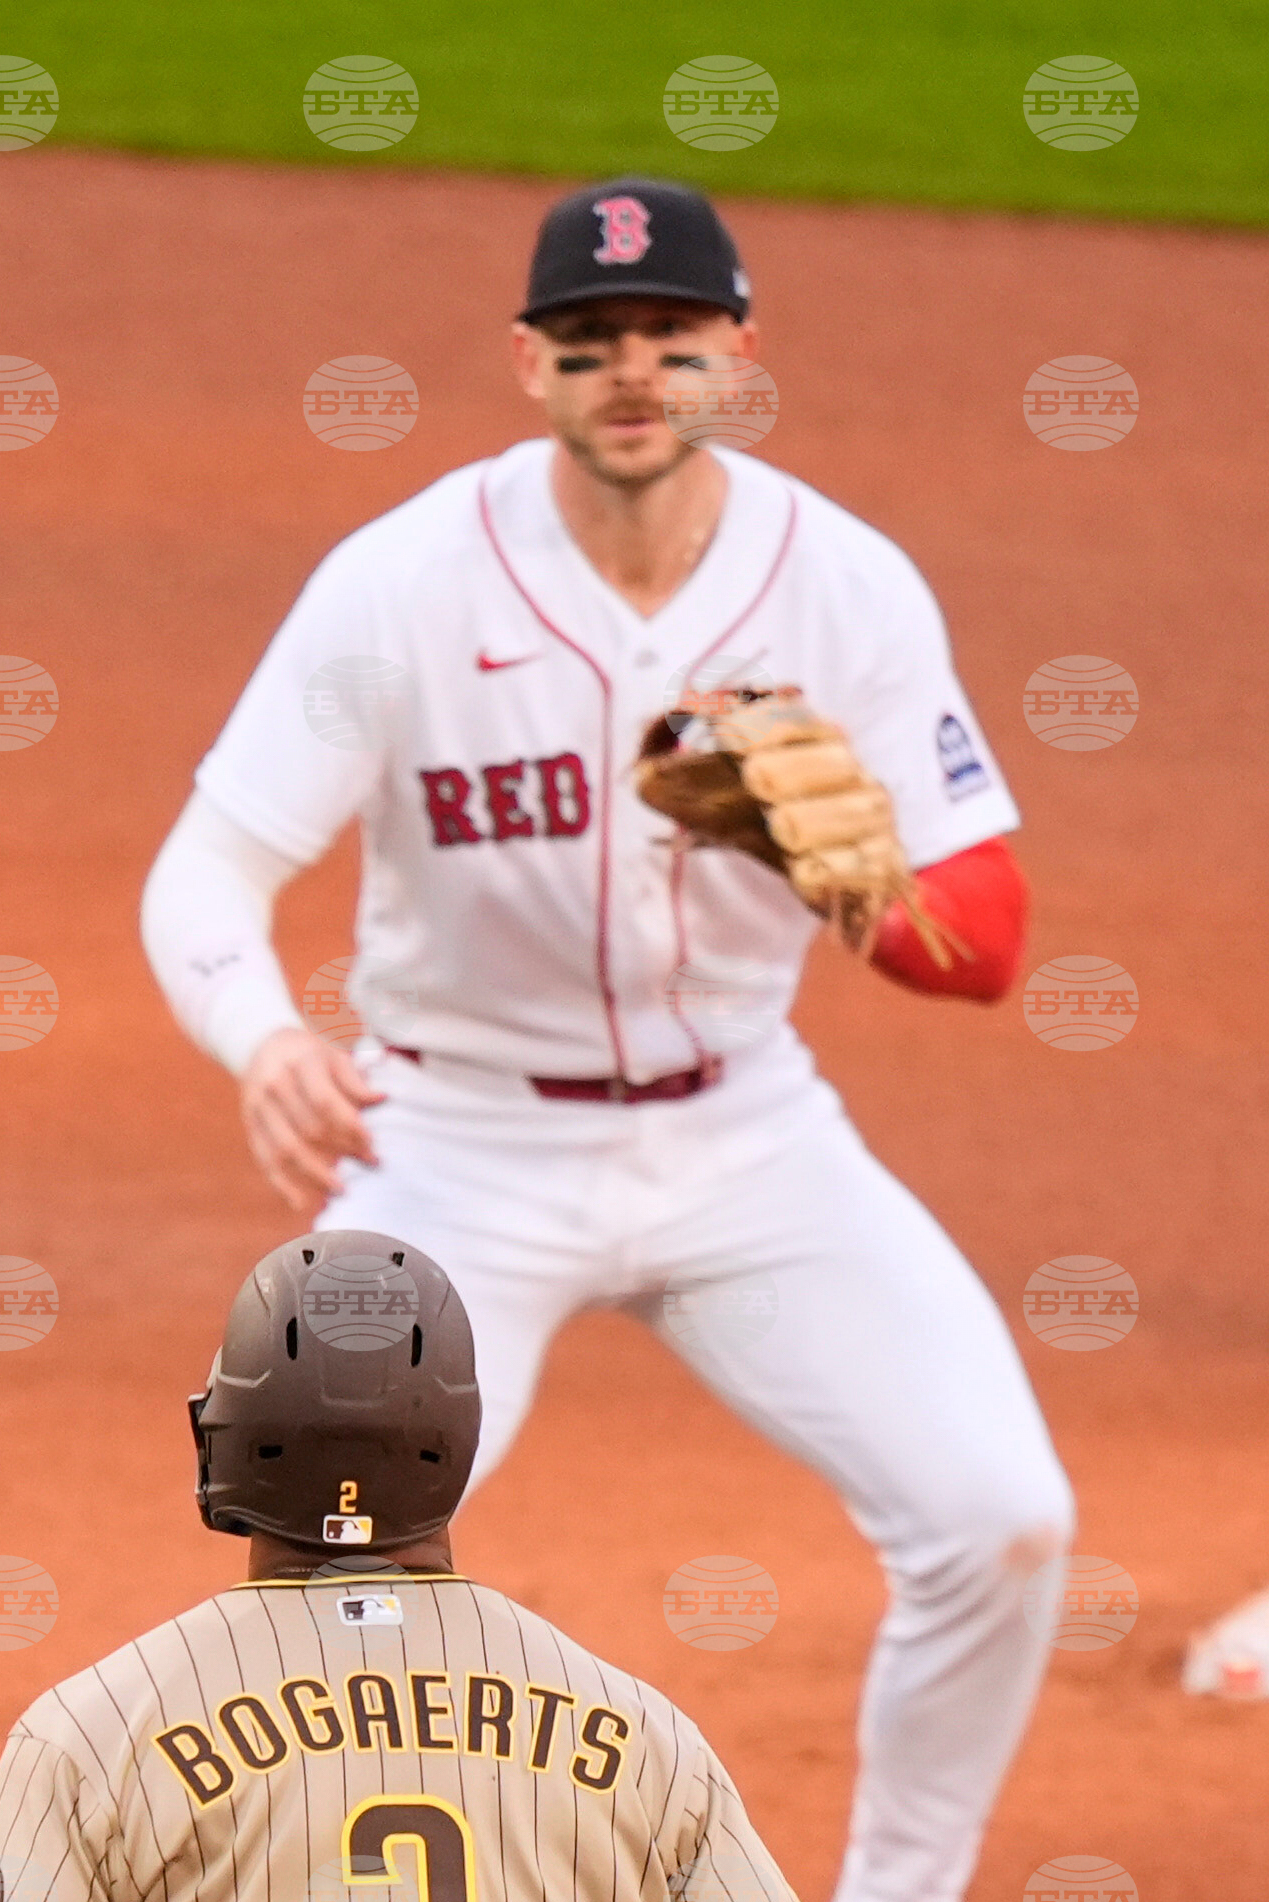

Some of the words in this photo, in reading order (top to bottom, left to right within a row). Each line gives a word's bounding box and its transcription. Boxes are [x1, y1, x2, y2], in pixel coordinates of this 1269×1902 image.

[593, 196, 652, 265] B
[418, 752, 590, 849] RED
[339, 1480, 358, 1514] 2
[153, 1670, 630, 1810] BOGAERTS
